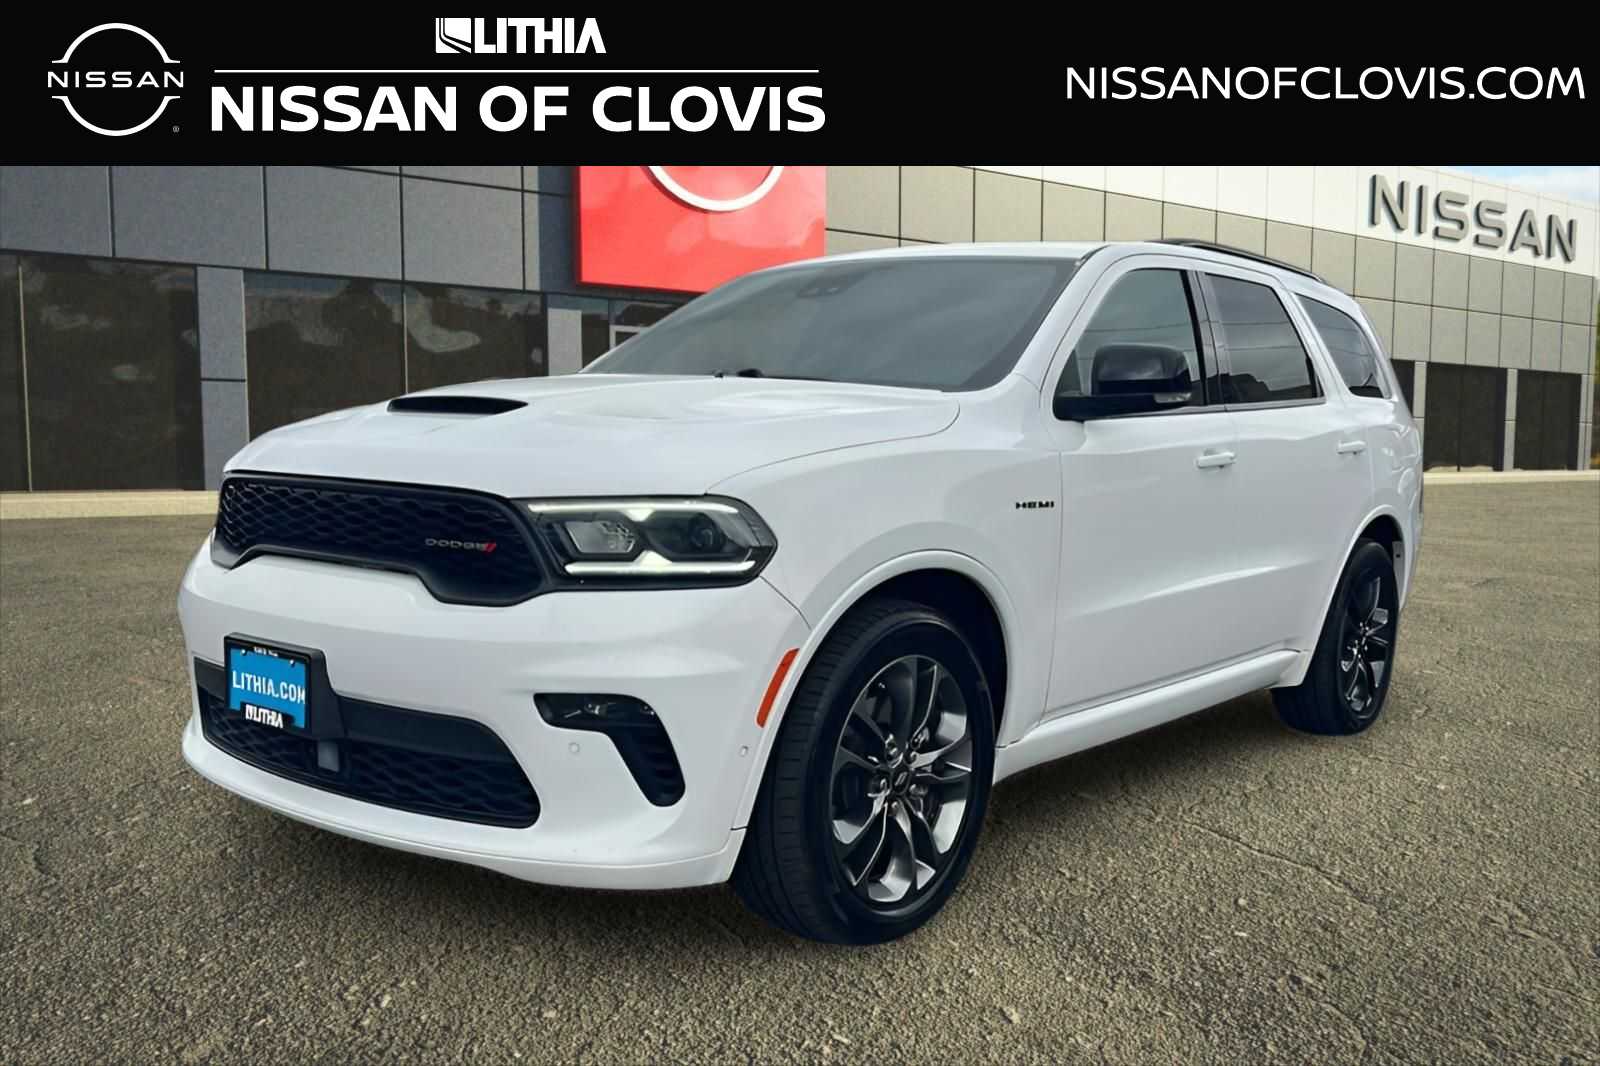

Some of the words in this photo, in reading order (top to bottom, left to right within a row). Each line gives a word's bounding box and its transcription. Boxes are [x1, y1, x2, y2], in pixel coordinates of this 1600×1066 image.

[1370, 174, 1577, 263] NISSAN
[1015, 501, 1055, 509] HEMI
[425, 538, 485, 552] DODGE
